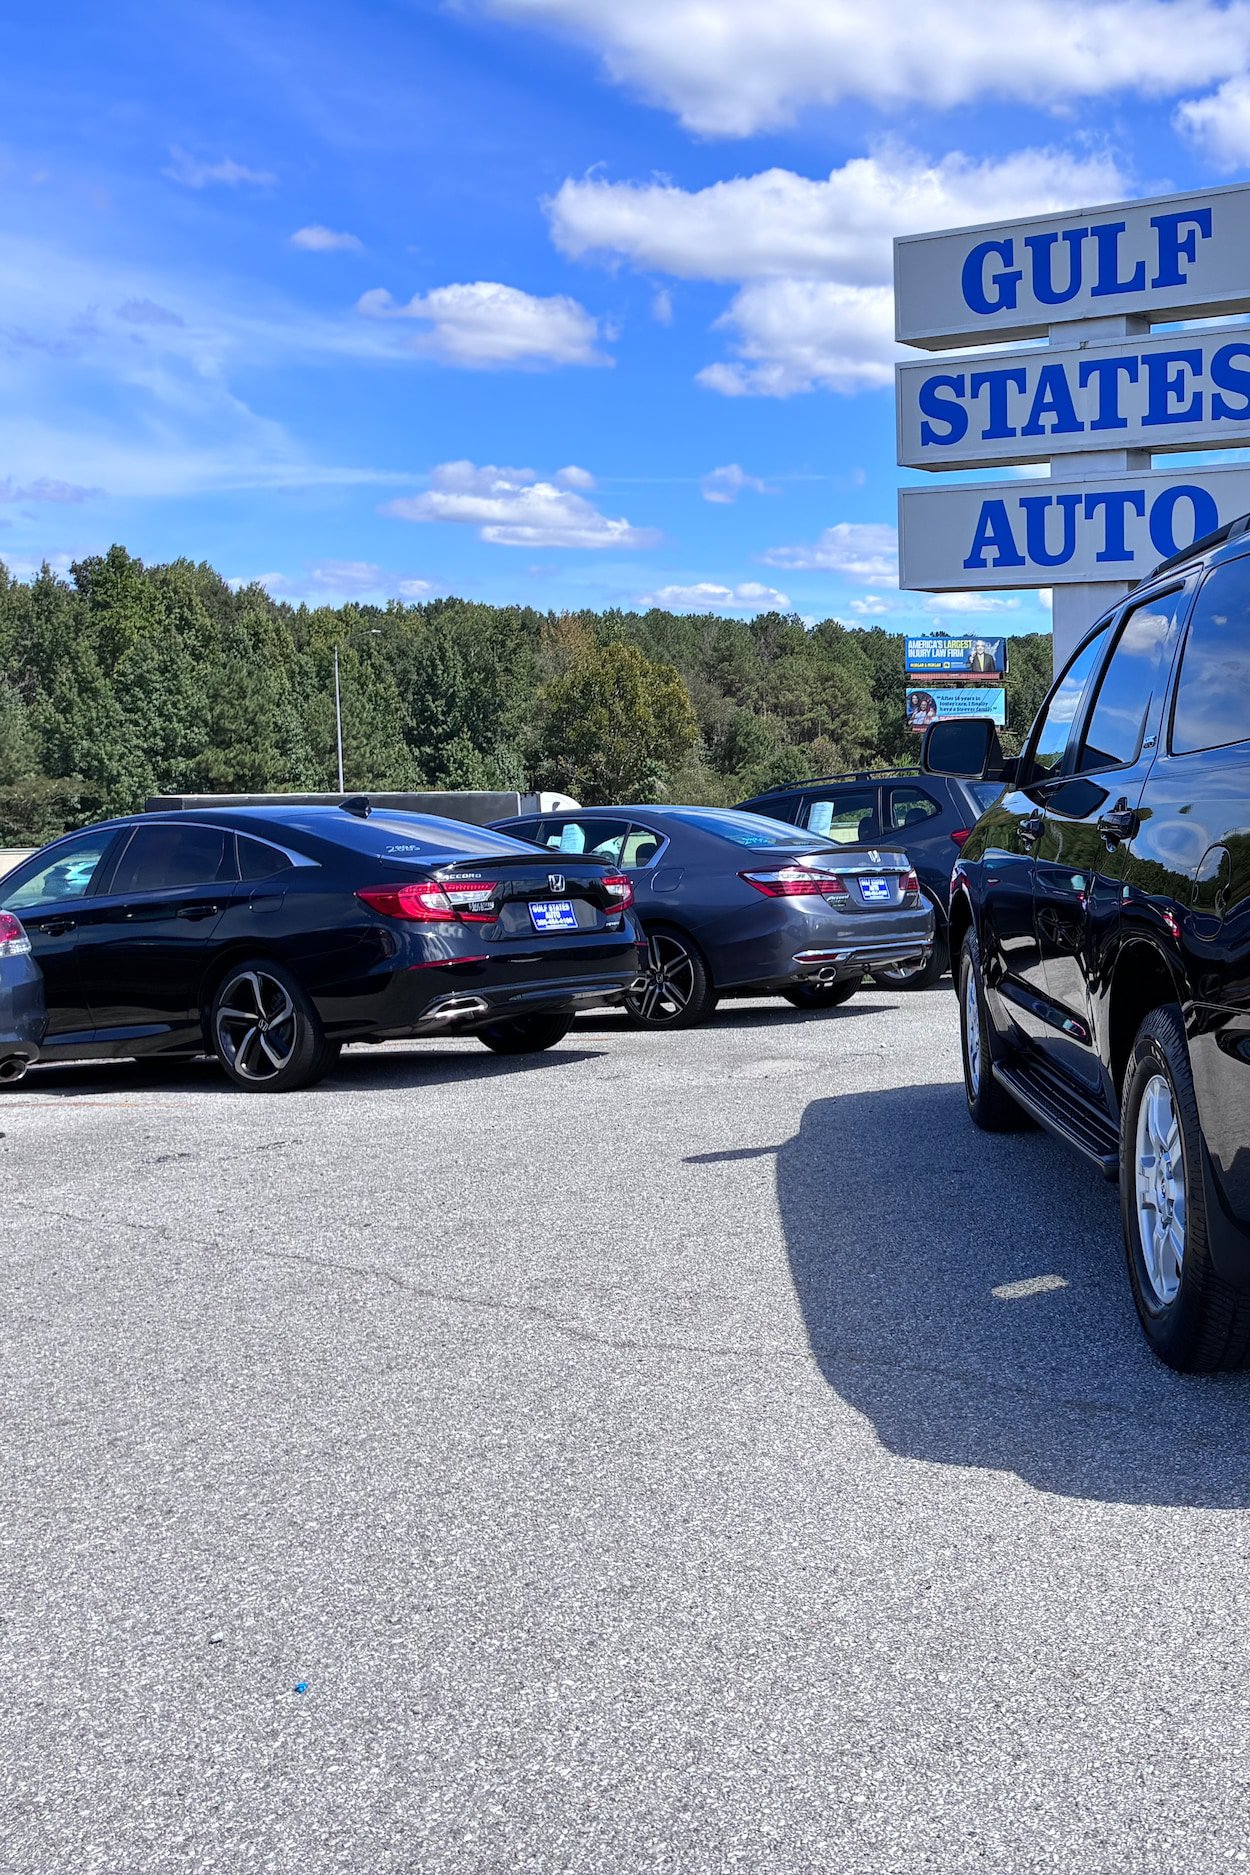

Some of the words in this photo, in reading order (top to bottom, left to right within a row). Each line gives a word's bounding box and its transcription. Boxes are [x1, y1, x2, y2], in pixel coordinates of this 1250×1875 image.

[961, 207, 1212, 315] GULF
[963, 484, 1219, 569] AUTO
[908, 640, 943, 649] AMERICA'S
[943, 640, 972, 649] LARGEST
[908, 649, 932, 658] INJURY
[932, 649, 946, 658] LAW
[947, 649, 964, 658] FIRM
